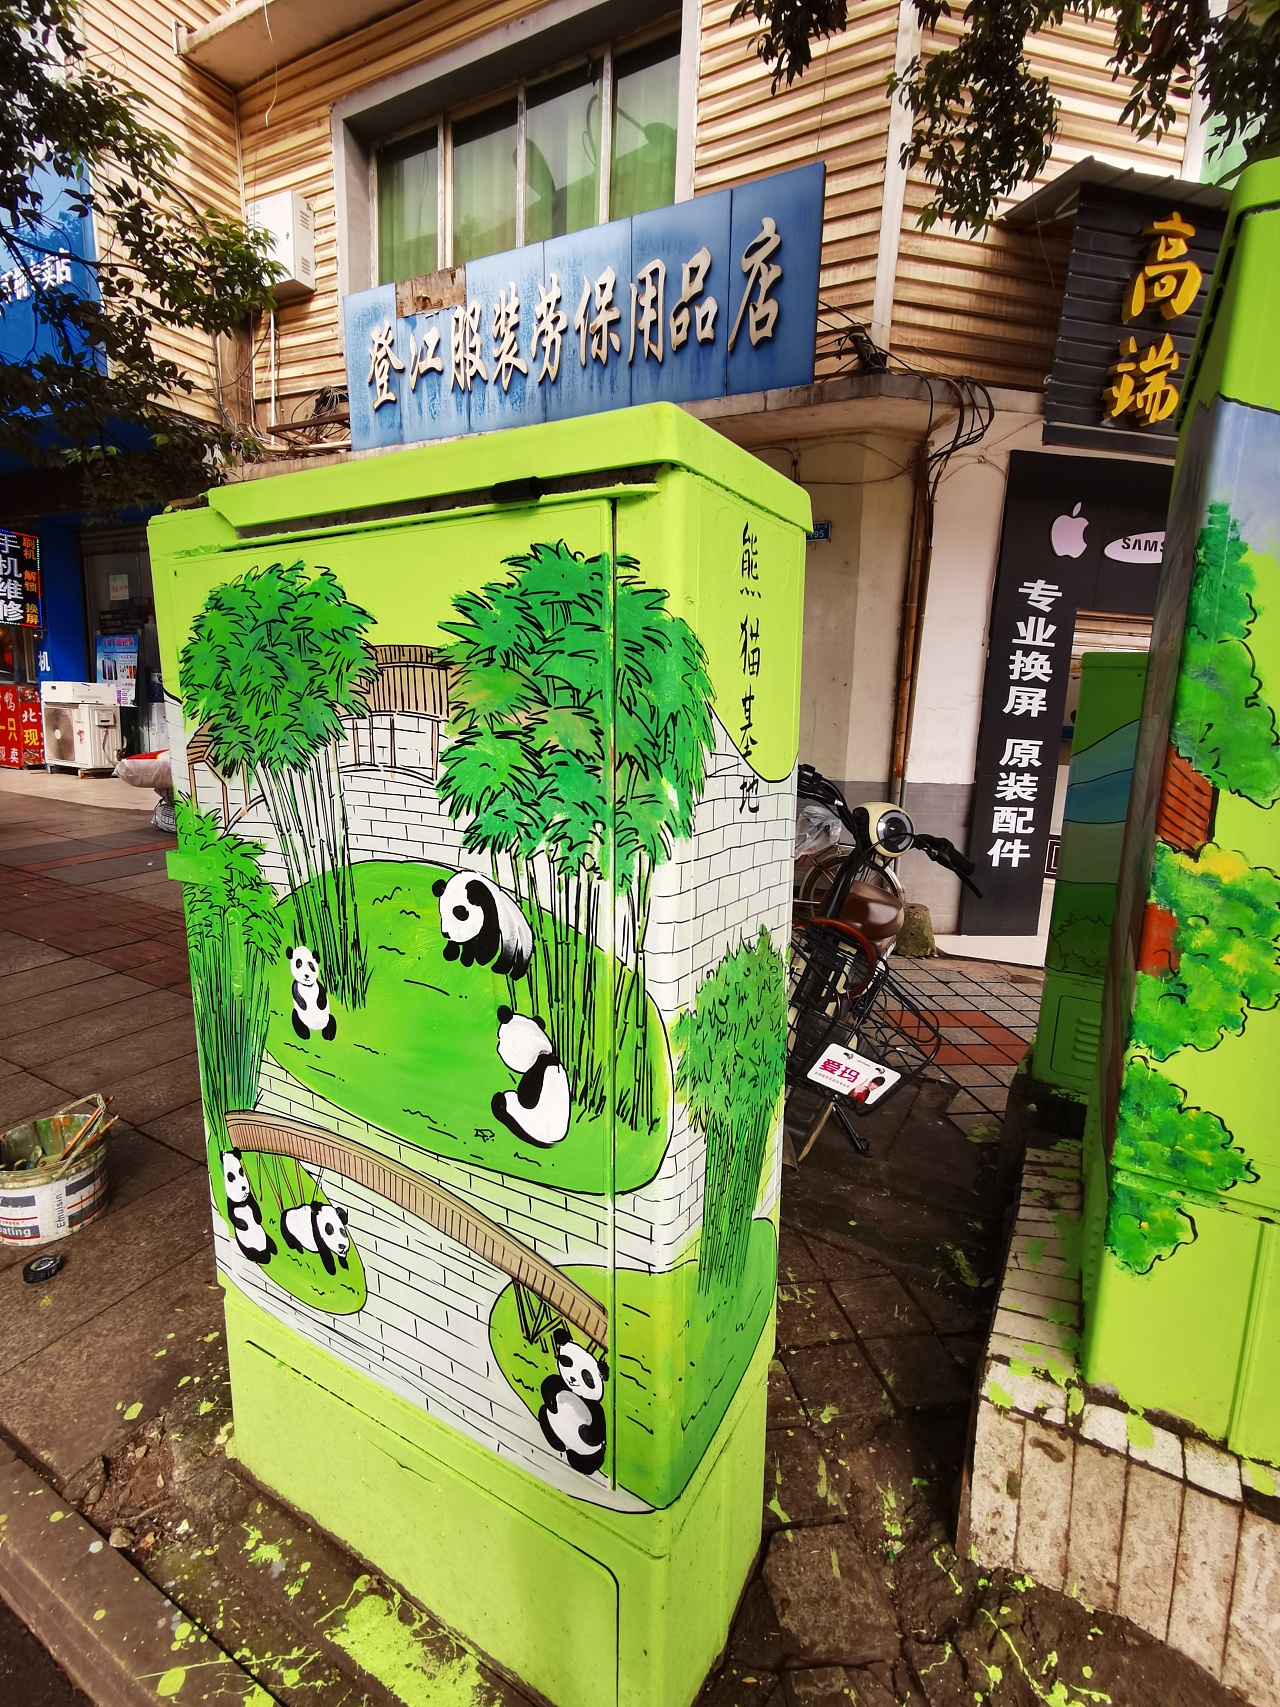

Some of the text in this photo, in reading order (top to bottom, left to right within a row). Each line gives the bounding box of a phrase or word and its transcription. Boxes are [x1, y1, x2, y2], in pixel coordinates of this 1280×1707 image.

[366, 217, 782, 411] 登江服装劳保用品店
[1106, 211, 1203, 425] 高端
[0, 533, 24, 622] 手机维修
[987, 578, 1063, 868] 专业换屏 原装配件
[819, 1058, 860, 1084] 爱玛
